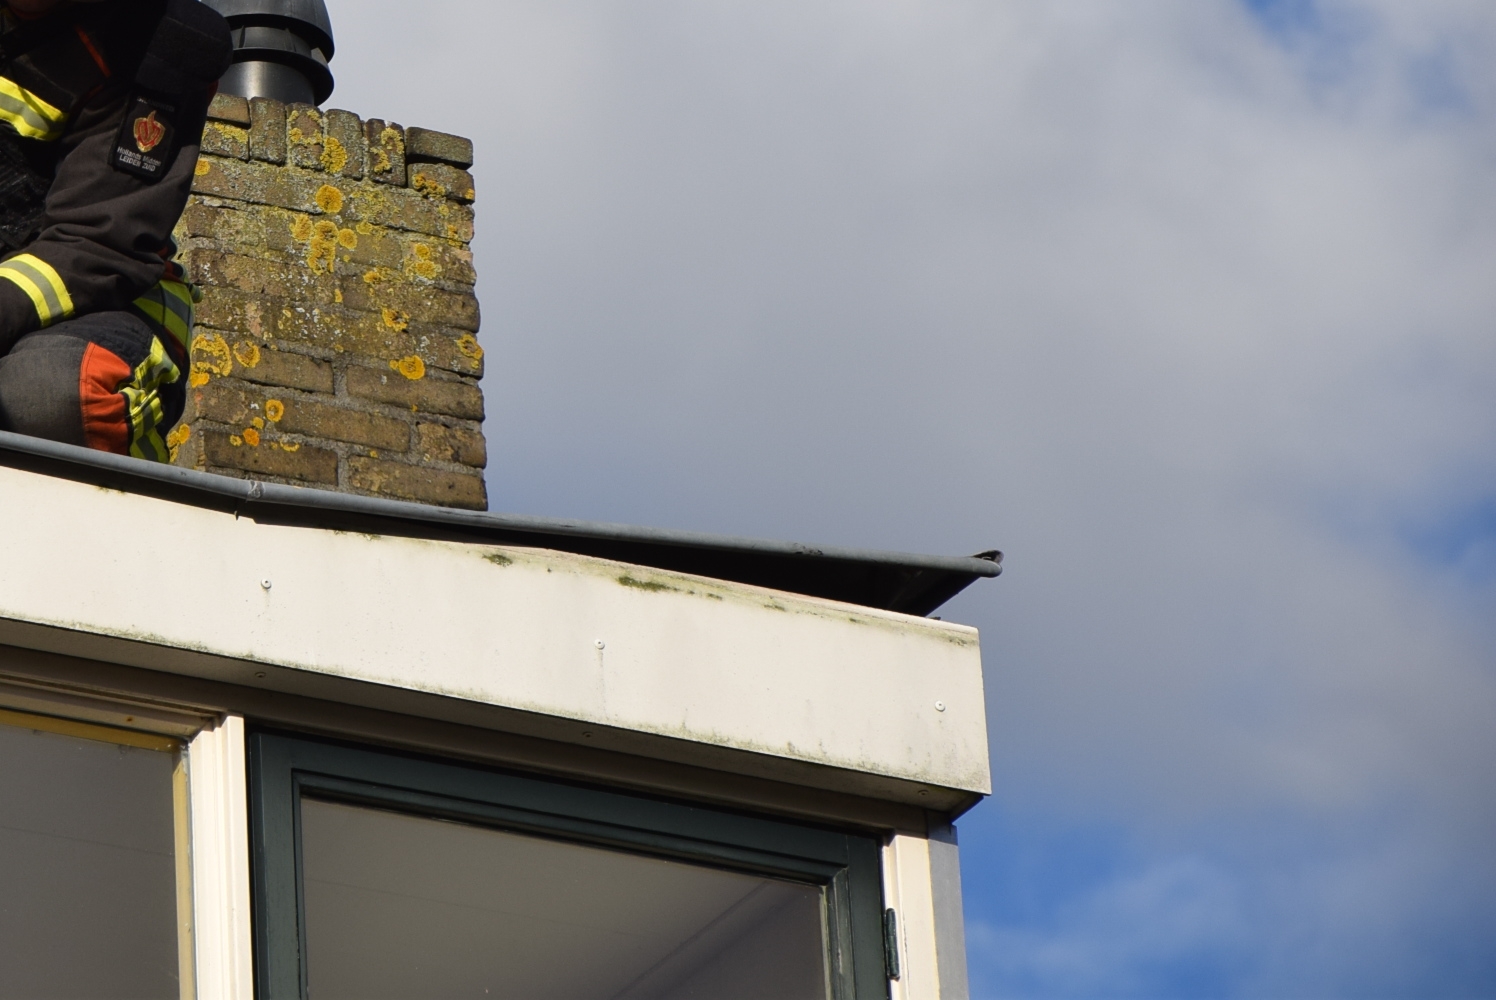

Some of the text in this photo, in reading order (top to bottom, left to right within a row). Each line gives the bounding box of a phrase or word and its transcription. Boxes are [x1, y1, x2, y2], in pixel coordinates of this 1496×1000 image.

[117, 146, 141, 159] Hollands
[119, 154, 156, 172] LEIDEN ZUID
